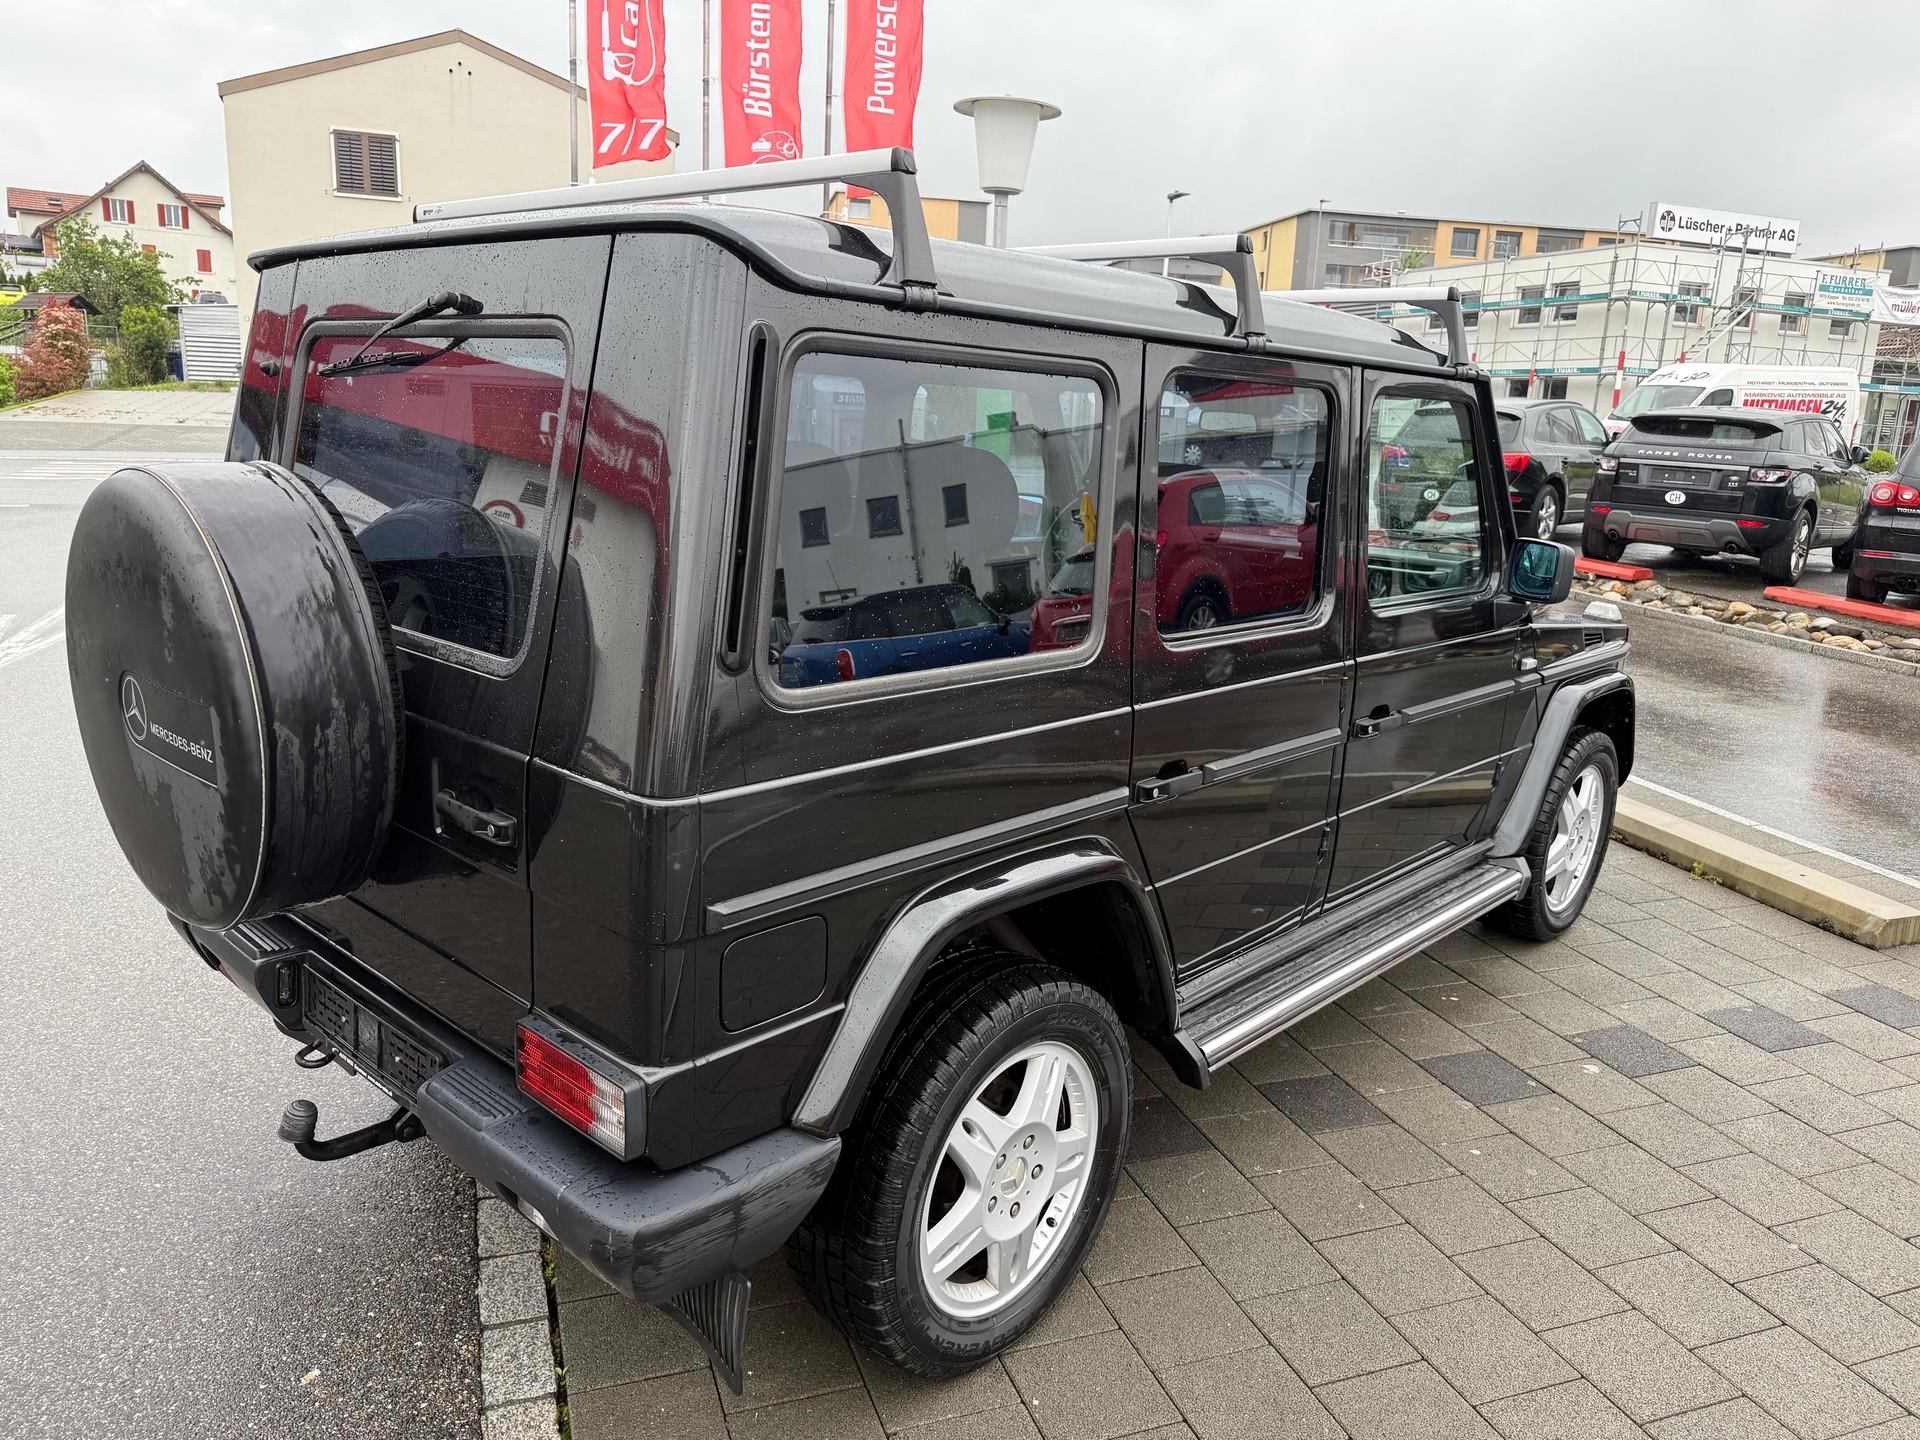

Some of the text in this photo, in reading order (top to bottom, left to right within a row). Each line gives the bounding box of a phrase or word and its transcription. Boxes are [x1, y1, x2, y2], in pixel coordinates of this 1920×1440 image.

[742, 3, 772, 118] Bürsten
[597, 118, 665, 156] 7/7
[1678, 215, 1725, 234] Lüscher
[1779, 228, 1796, 241] AG
[1638, 449, 1733, 460] RANGE ROVER
[1669, 492, 1681, 503] CH
[150, 721, 214, 764] MERCEDES-BENZ
